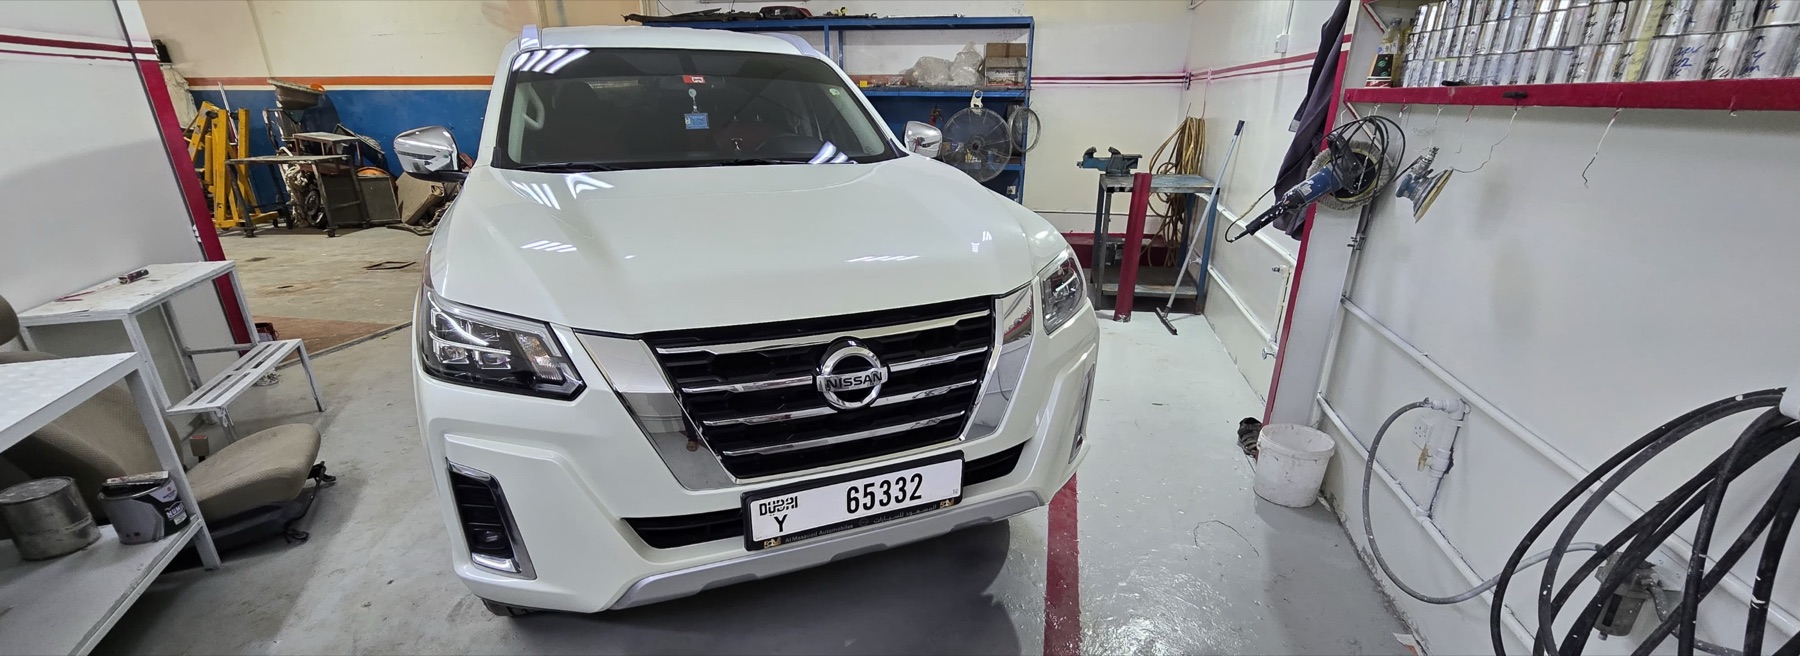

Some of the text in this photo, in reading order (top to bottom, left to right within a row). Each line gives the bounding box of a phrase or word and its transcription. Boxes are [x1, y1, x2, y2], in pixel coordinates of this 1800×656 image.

[826, 371, 883, 389] NISSAN
[846, 473, 923, 514] 65332
[773, 513, 788, 533] Y
[819, 524, 854, 536] Automobiles
